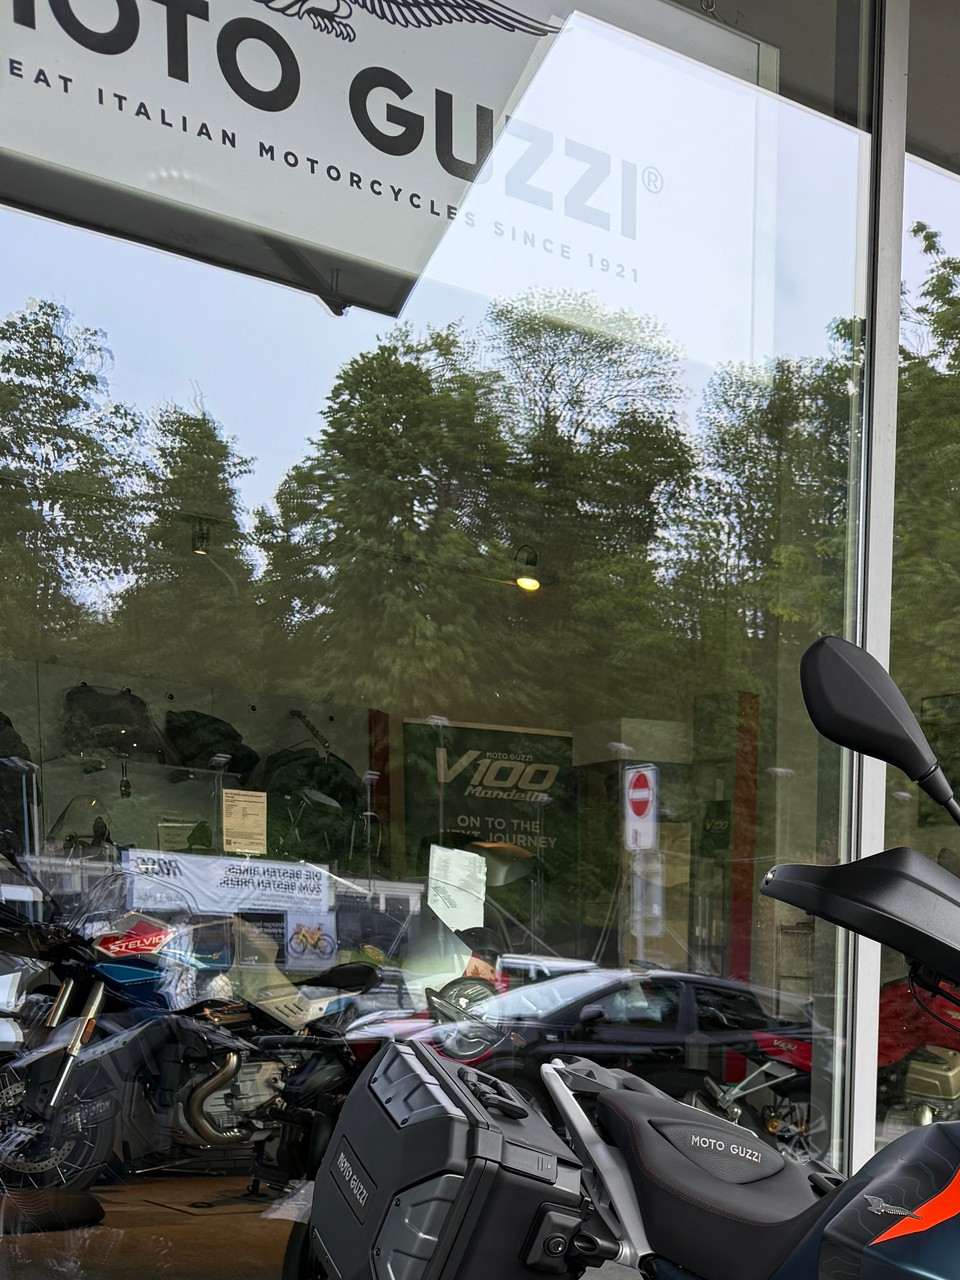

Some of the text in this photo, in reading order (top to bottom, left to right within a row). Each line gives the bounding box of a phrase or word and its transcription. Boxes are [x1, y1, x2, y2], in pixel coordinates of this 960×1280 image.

[13, 0, 301, 112] OTO
[98, 87, 236, 148] ITALIAN
[258, 141, 477, 228] MOTORCYCLES
[494, 222, 571, 260] SINCE
[588, 253, 640, 284] 1921
[435, 747, 560, 790] V100
[486, 751, 533, 762] MOTO GUZZI
[457, 815, 540, 833] ON TO THE
[486, 832, 558, 849] JOURNEY
[109, 934, 165, 952] STELVIO
[691, 1135, 762, 1164] MOTO GUZZI
[337, 1152, 369, 1207] MOTO GUZZI
